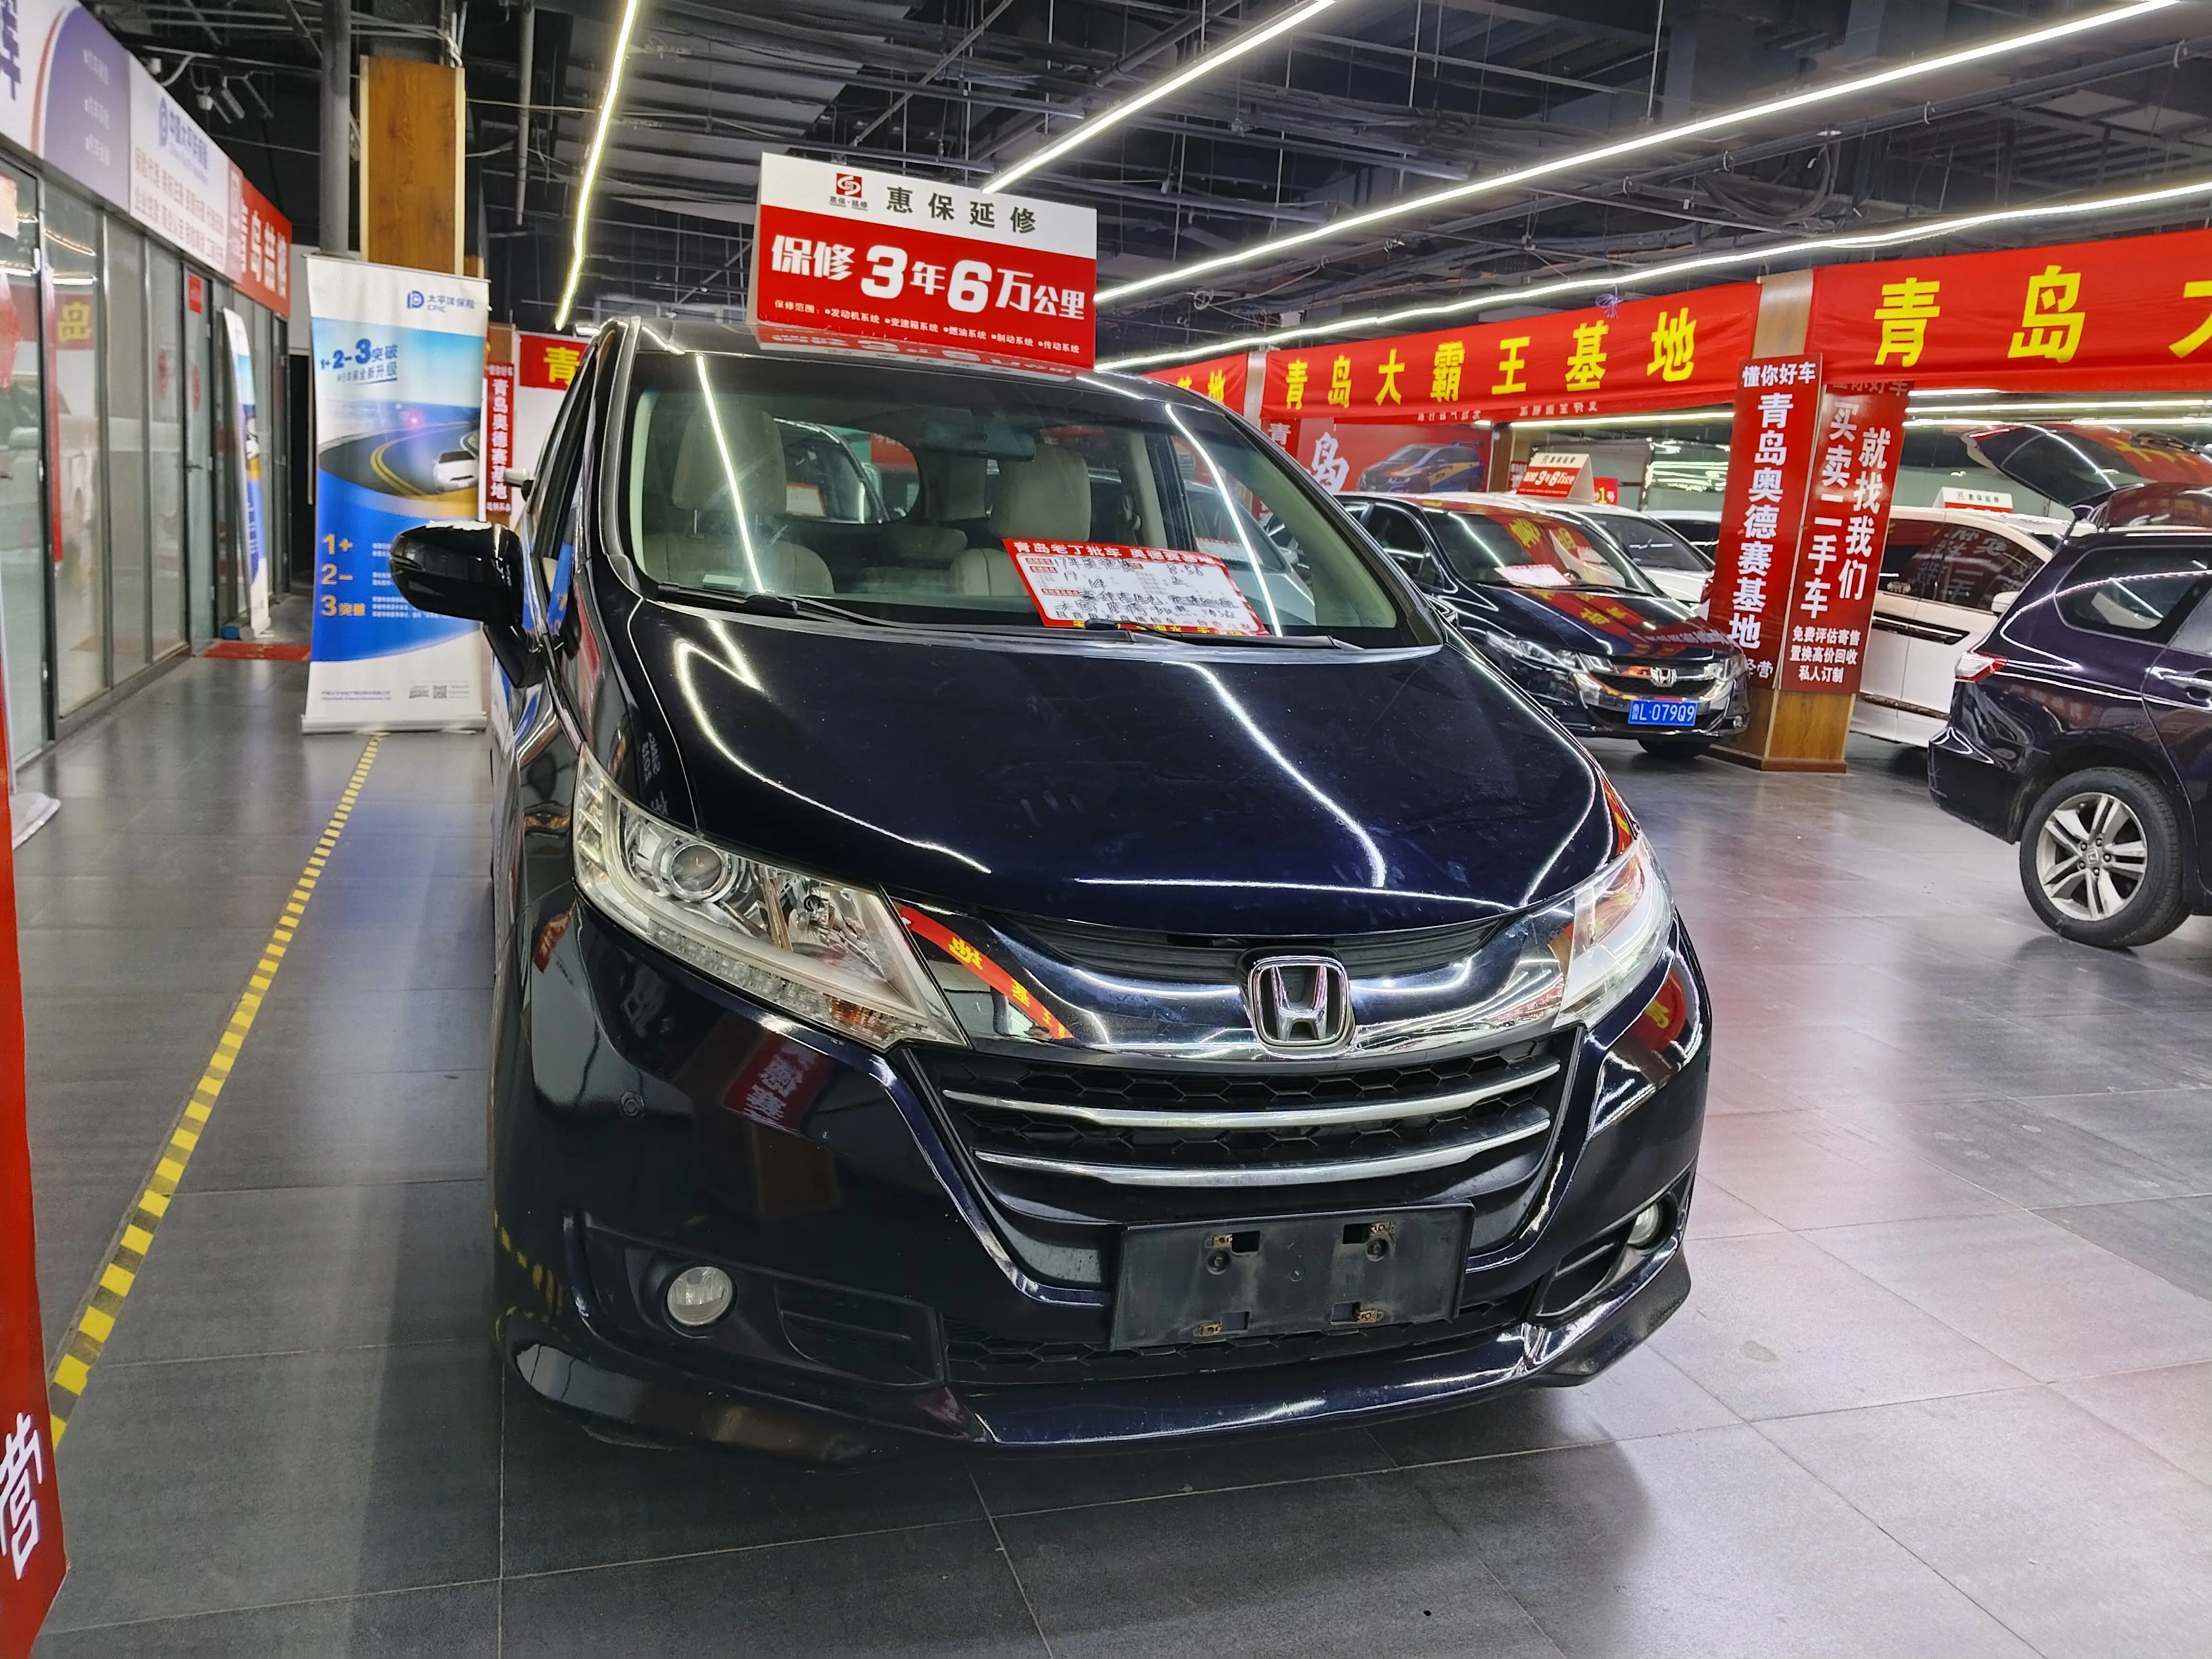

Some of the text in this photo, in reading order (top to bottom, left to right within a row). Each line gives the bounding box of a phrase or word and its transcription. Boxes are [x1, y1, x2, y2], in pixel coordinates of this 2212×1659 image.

[886, 186, 1037, 234] 惠保延修
[771, 235, 1085, 320] 保修3年6万公里
[427, 294, 475, 309] 太平洋保险
[830, 309, 880, 325] 发动机系统
[890, 317, 939, 334] 变速箱系统
[949, 326, 987, 341] 燃油系统
[996, 334, 1034, 348] 制动系统
[1043, 340, 1080, 354] 传动系统
[543, 347, 580, 387] 青
[1286, 307, 1696, 410] 青岛大霸王基地
[1742, 361, 1816, 387] 懂你好车
[1728, 393, 1794, 649] 青岛奥德赛基地
[1800, 400, 1859, 619] 买卖二手车
[1838, 427, 1891, 601] 就找我们
[323, 534, 353, 554] 1+
[1013, 541, 1122, 558] 青岛老丁批车
[321, 595, 366, 617] 3突破
[1791, 625, 1861, 646] 免费评估寄售
[1789, 644, 1858, 665] 置换高价回收
[1798, 664, 1844, 684] 私人订制
